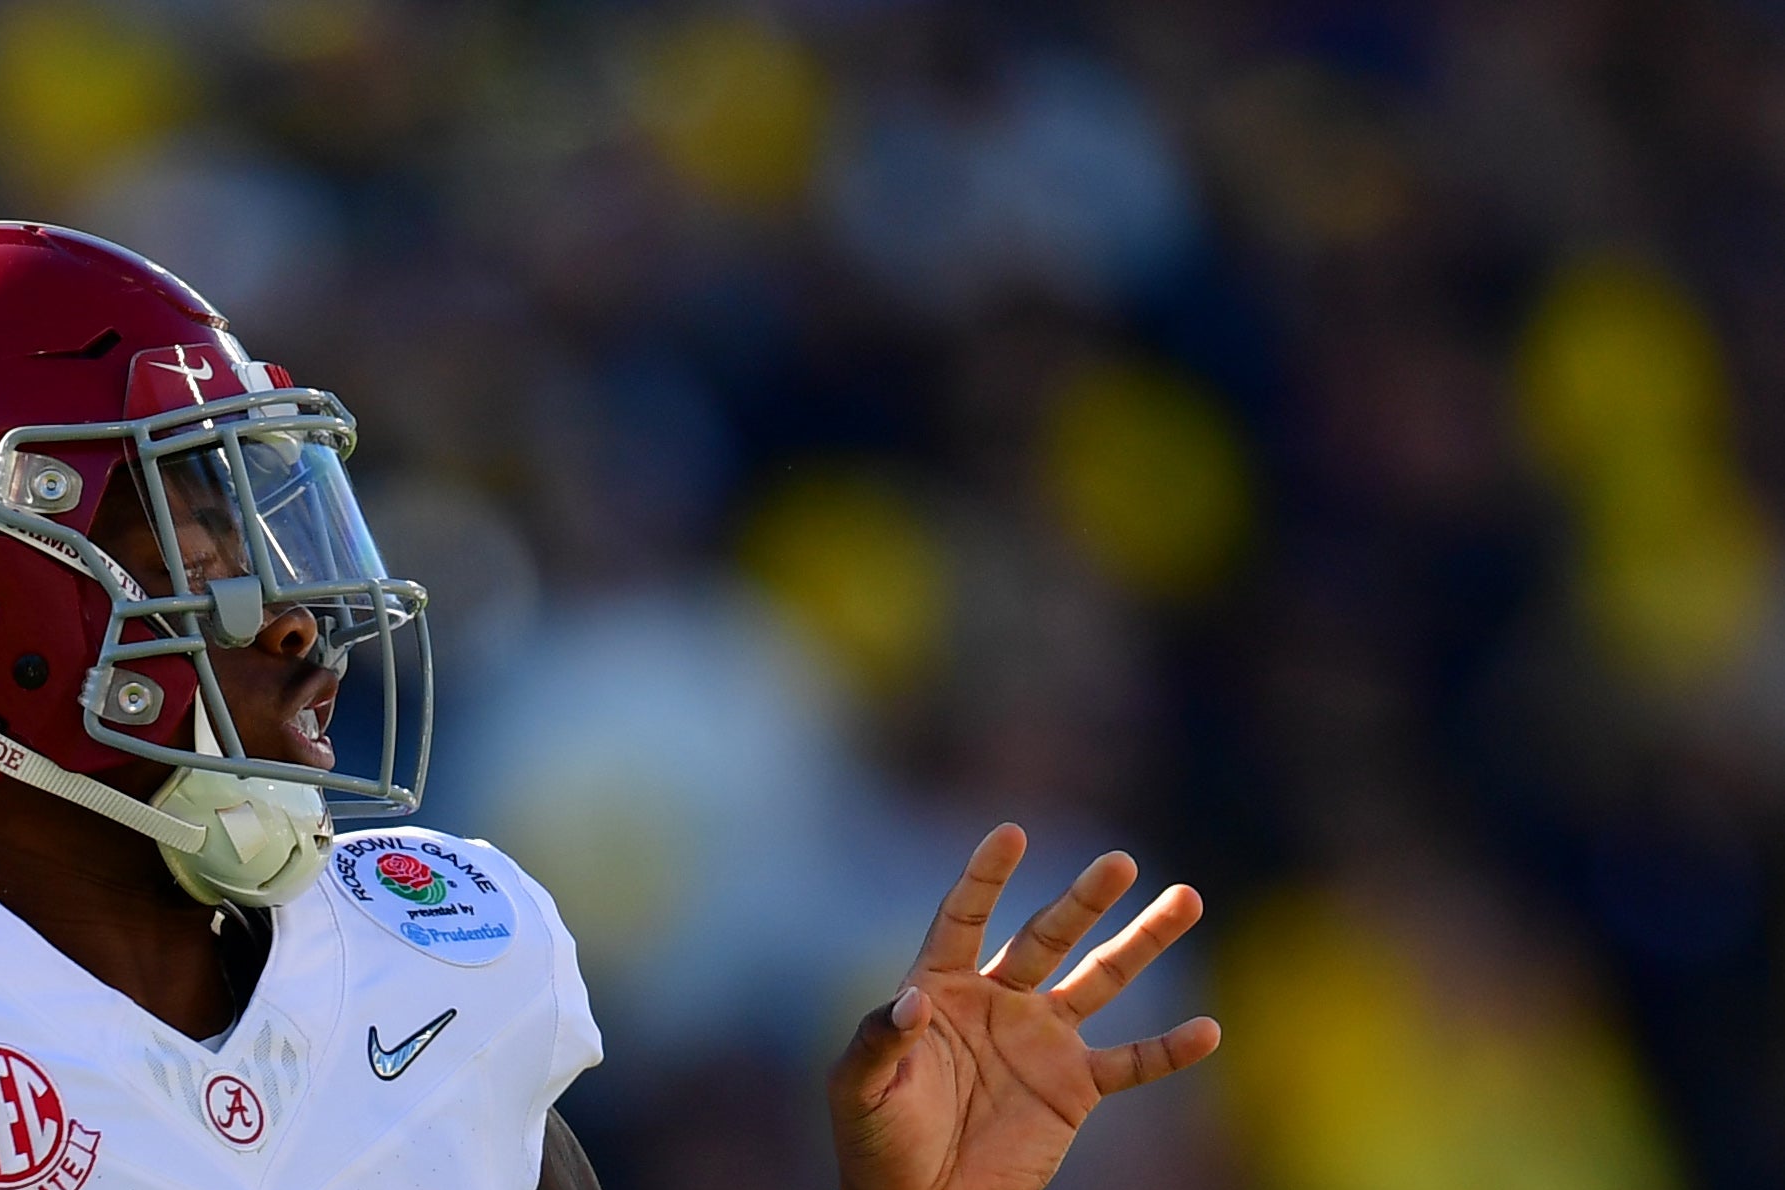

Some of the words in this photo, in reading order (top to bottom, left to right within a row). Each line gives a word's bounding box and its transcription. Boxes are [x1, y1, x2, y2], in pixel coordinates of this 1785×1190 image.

[342, 837, 417, 859] BOWL
[336, 852, 374, 902] ROSE
[420, 841, 498, 894] GAME
[406, 903, 458, 920] presented
[458, 902, 475, 917] by
[426, 922, 511, 944] Prudential
[217, 1084, 253, 1129] A
